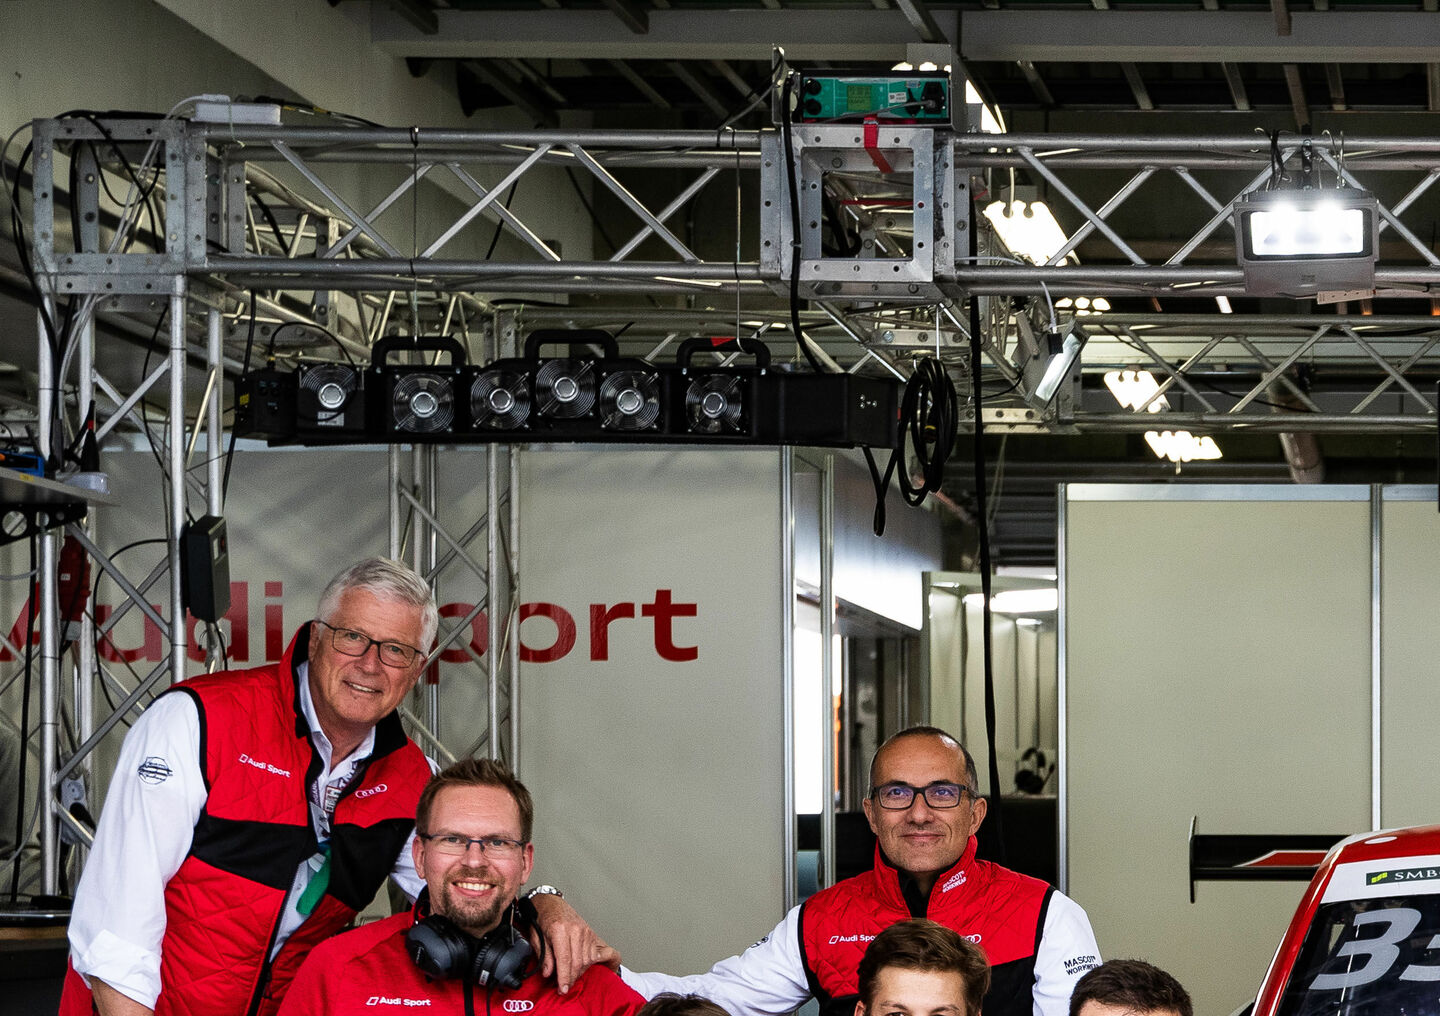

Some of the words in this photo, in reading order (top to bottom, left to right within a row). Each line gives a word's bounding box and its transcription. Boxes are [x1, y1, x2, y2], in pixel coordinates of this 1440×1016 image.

[248, 757, 267, 770] Audi
[267, 764, 292, 779] Sport
[838, 934, 859, 943] Audi
[379, 996, 402, 1006] Audi
[403, 997, 432, 1008] Sport
